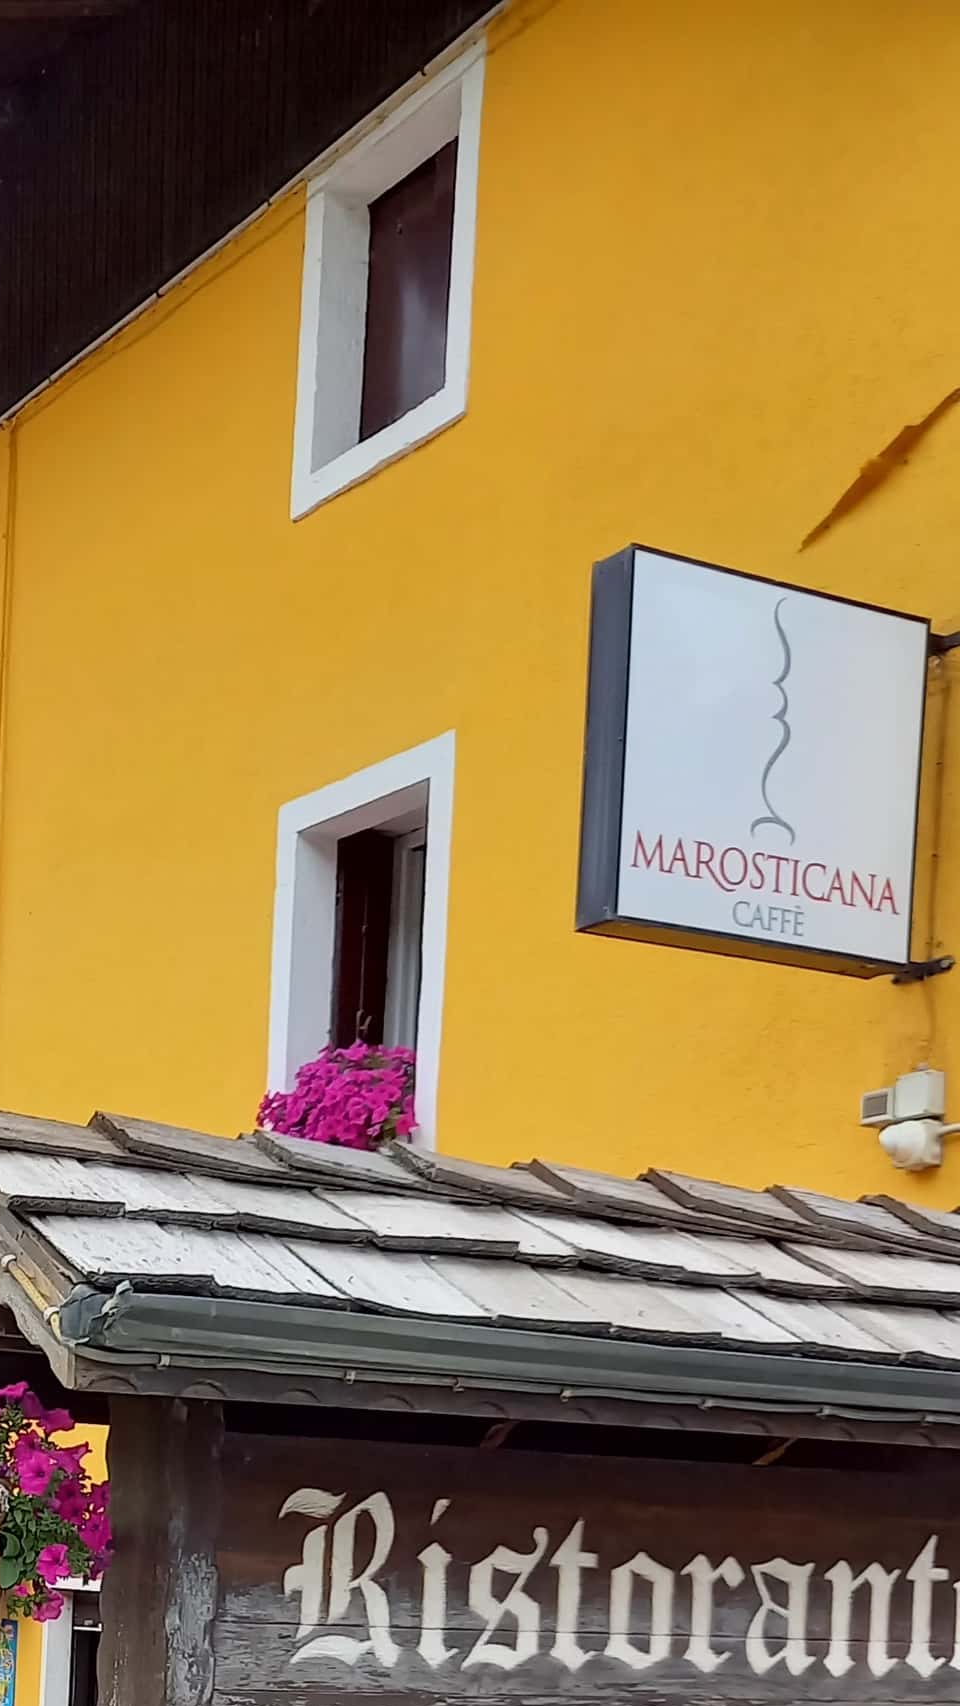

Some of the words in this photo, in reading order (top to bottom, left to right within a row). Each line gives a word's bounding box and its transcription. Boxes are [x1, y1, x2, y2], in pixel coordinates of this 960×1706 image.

[630, 830, 899, 916] MAROSTICANA
[732, 900, 804, 937] CAFFÈ
[279, 1488, 960, 1678] Ristorant
